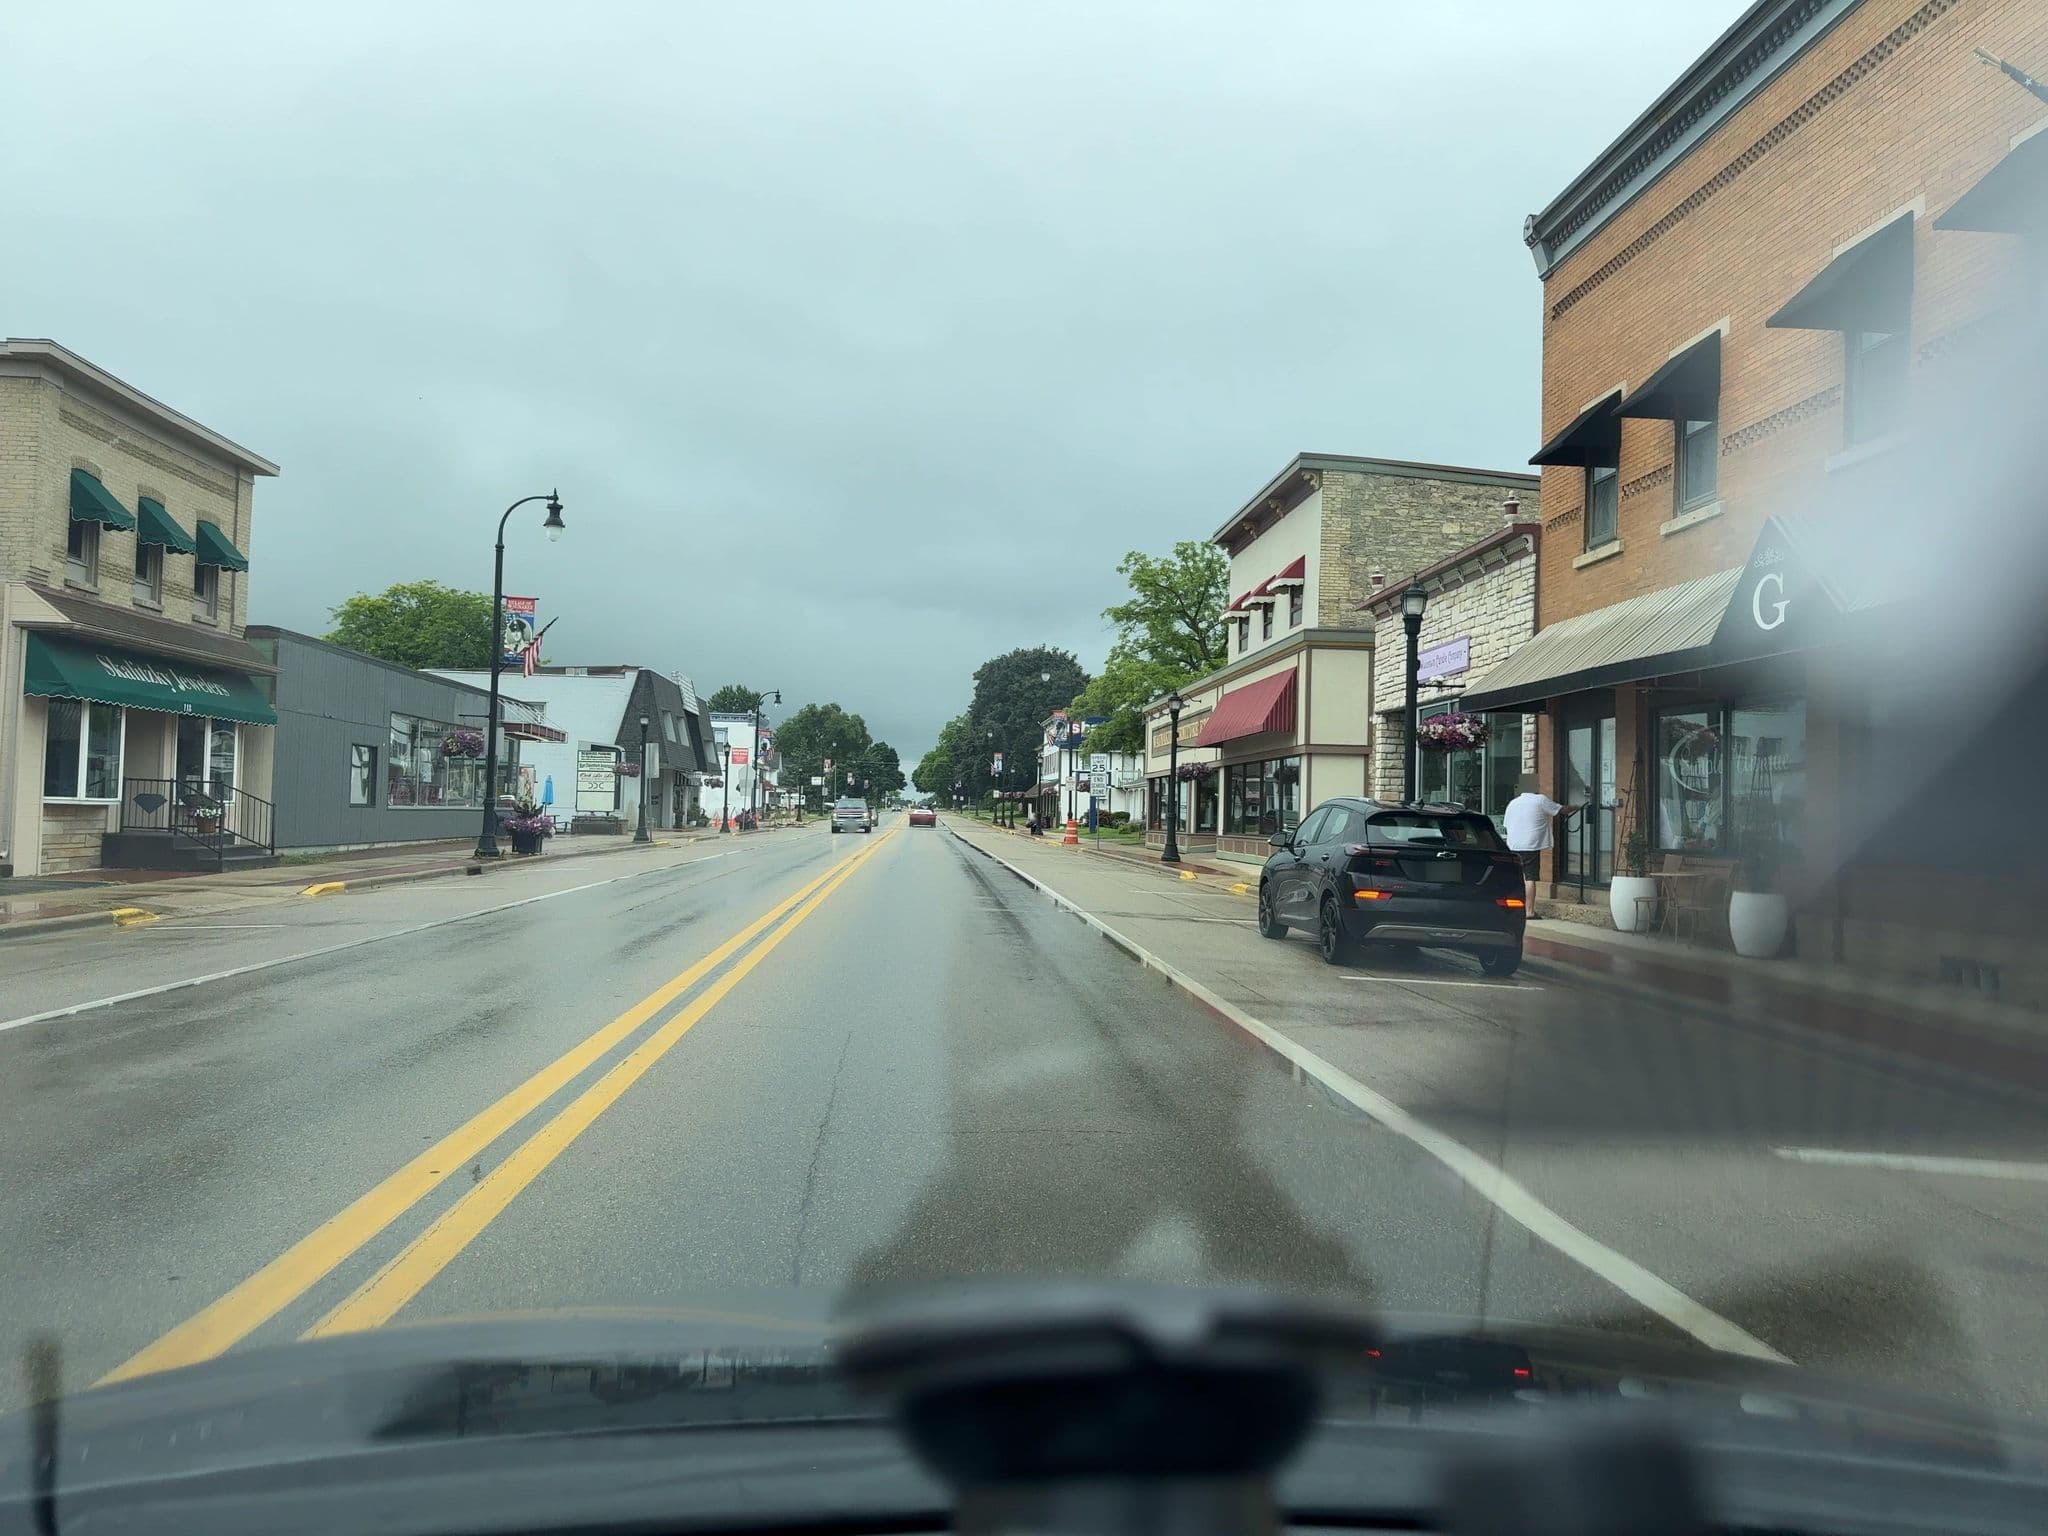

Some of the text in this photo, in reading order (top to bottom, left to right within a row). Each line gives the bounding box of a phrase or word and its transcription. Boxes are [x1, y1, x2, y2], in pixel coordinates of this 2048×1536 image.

[1752, 571, 1791, 630] G
[168, 668, 231, 697] Jewelers
[1092, 764, 1106, 773] 25
